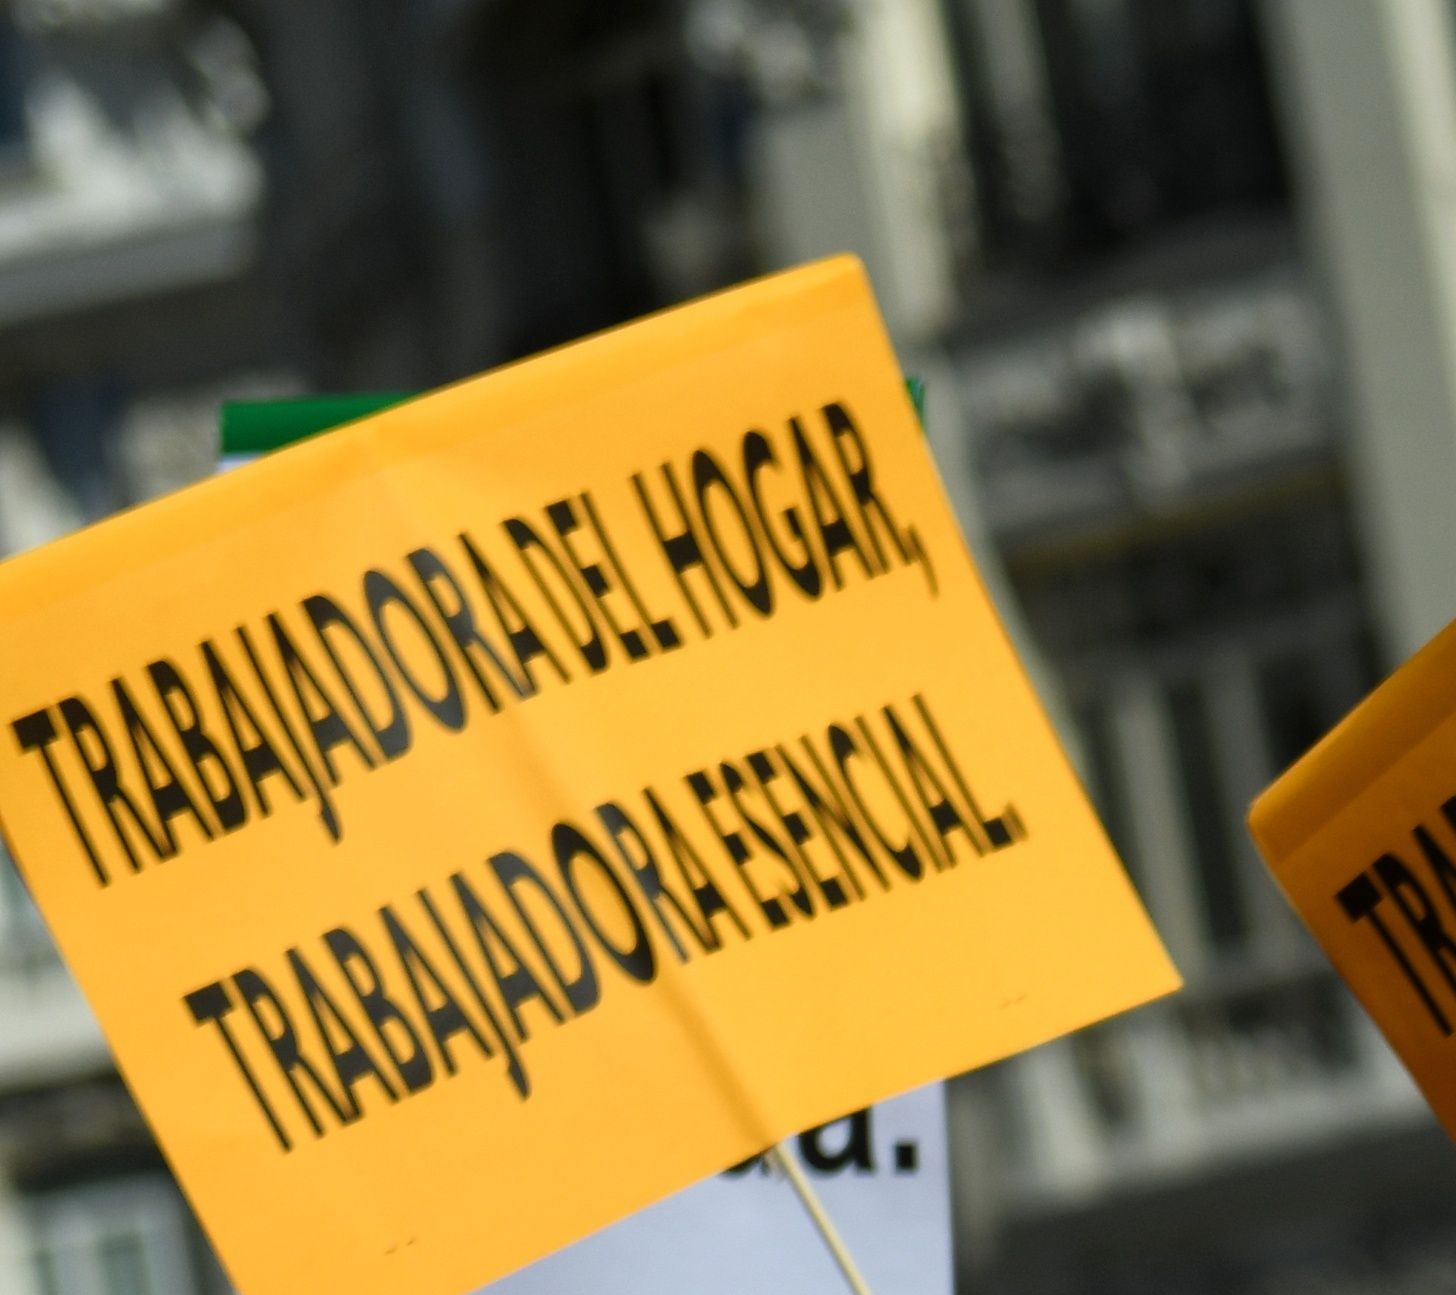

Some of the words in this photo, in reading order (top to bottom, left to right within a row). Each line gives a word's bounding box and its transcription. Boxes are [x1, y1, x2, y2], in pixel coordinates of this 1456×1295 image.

[12, 534, 540, 888] TRABAJADORA
[502, 491, 681, 676] DEL
[630, 400, 940, 641] HOGAR,
[184, 783, 752, 1152] TRABAJADORA
[685, 693, 1028, 930] ESENCIAL.
